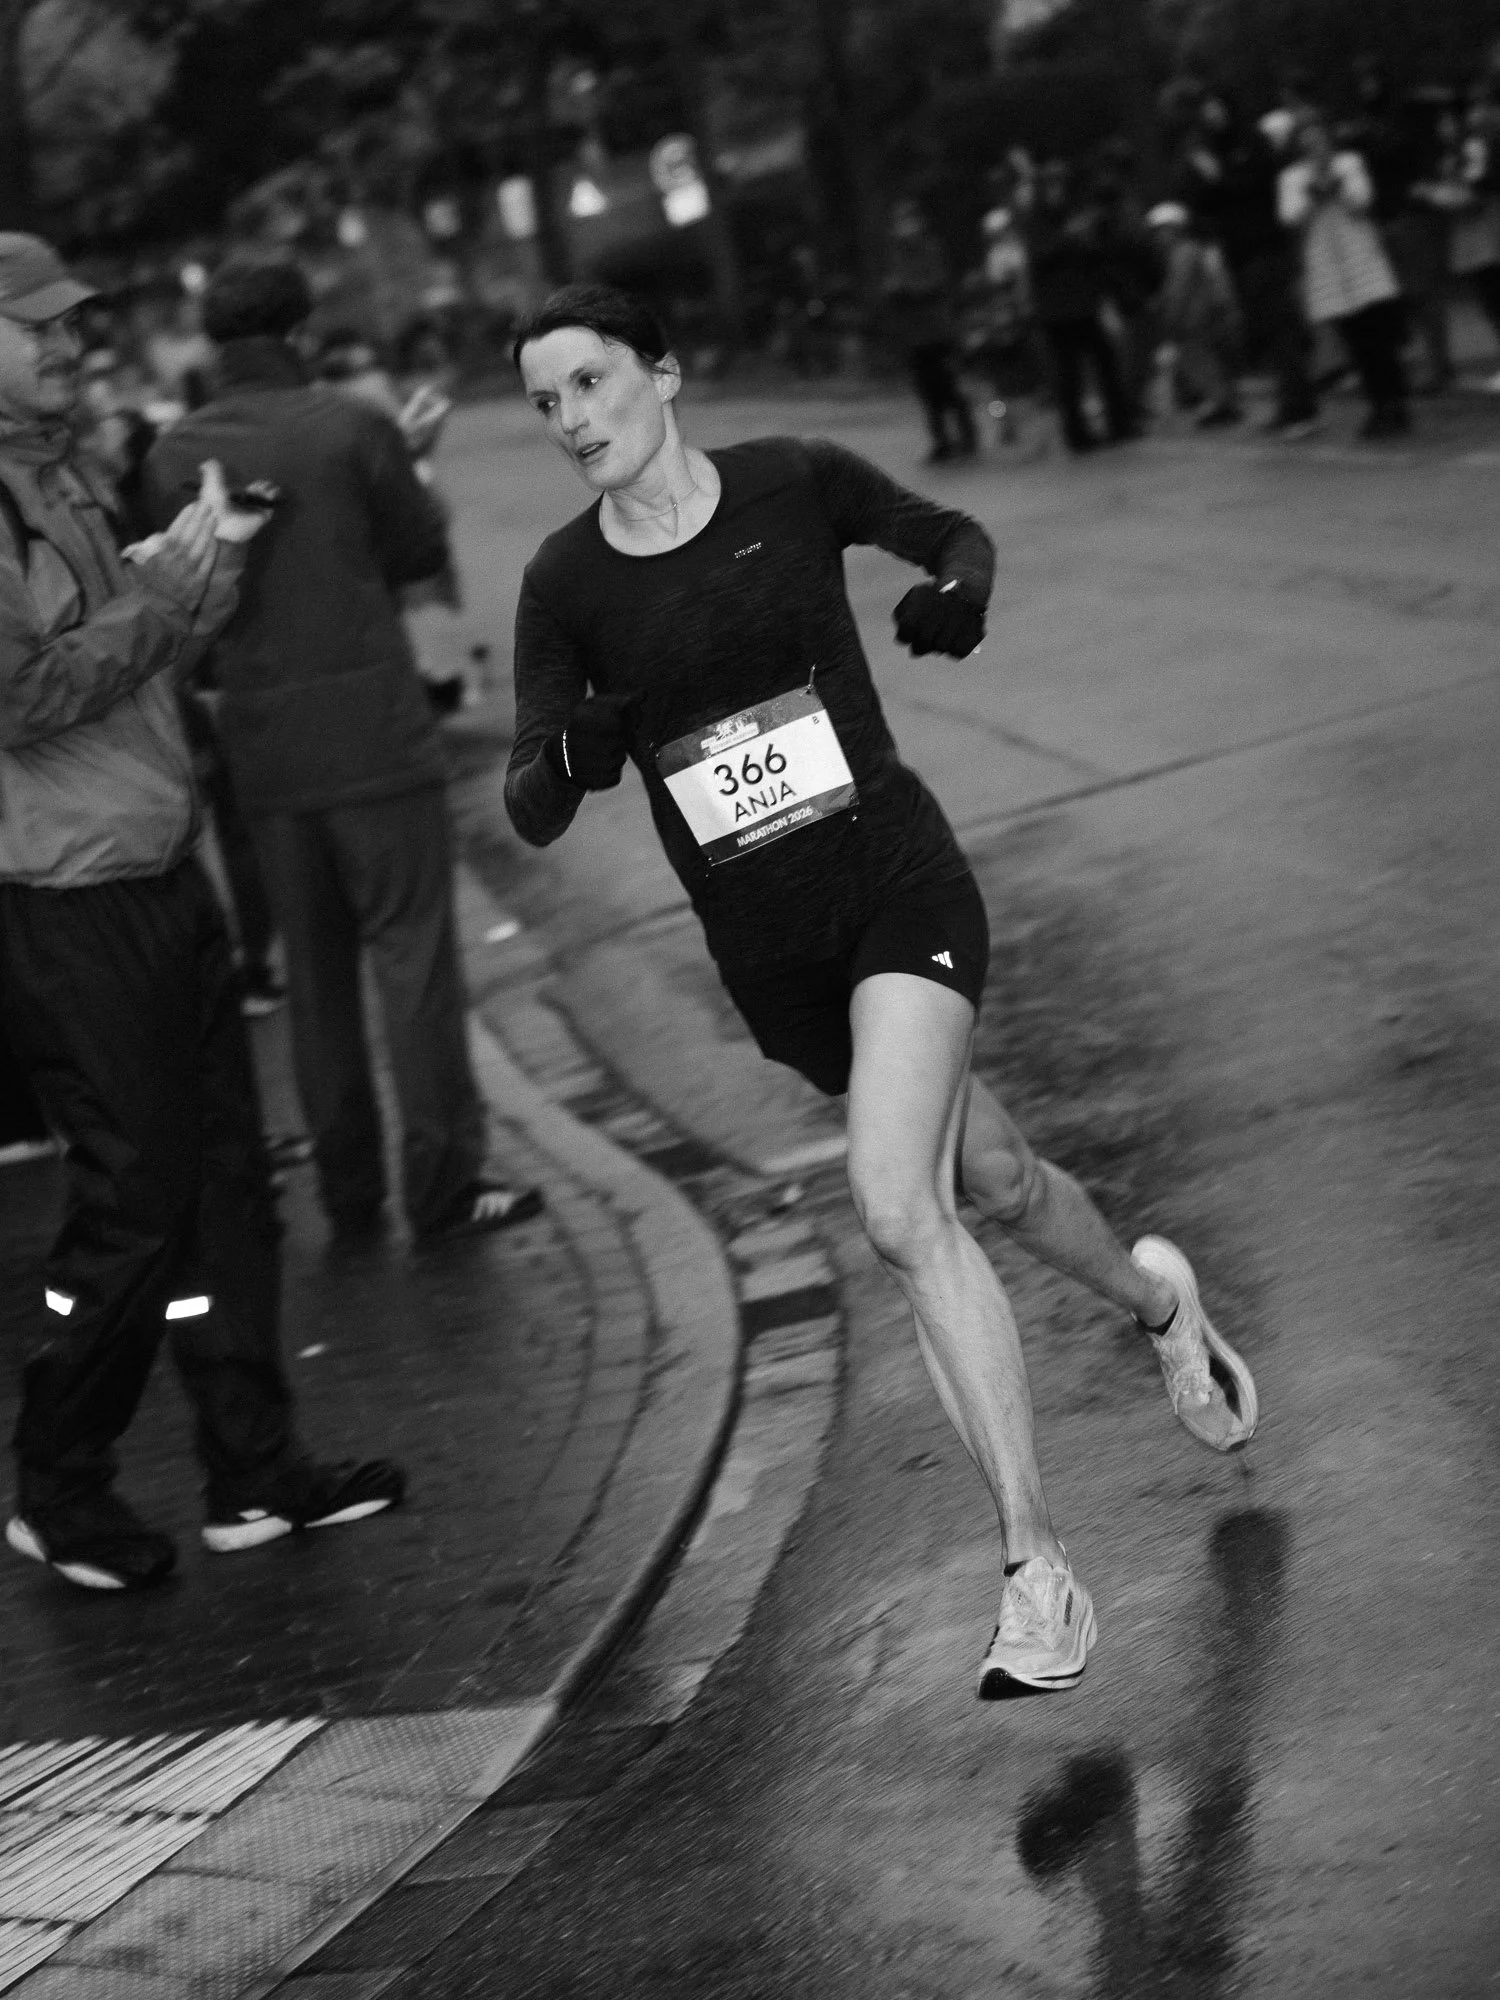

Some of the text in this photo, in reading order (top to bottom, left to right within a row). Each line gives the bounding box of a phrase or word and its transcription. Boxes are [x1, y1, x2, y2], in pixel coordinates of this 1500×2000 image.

[713, 743, 787, 796] 366
[735, 780, 797, 823] ANJA
[736, 805, 813, 847] MARATHON 2026
